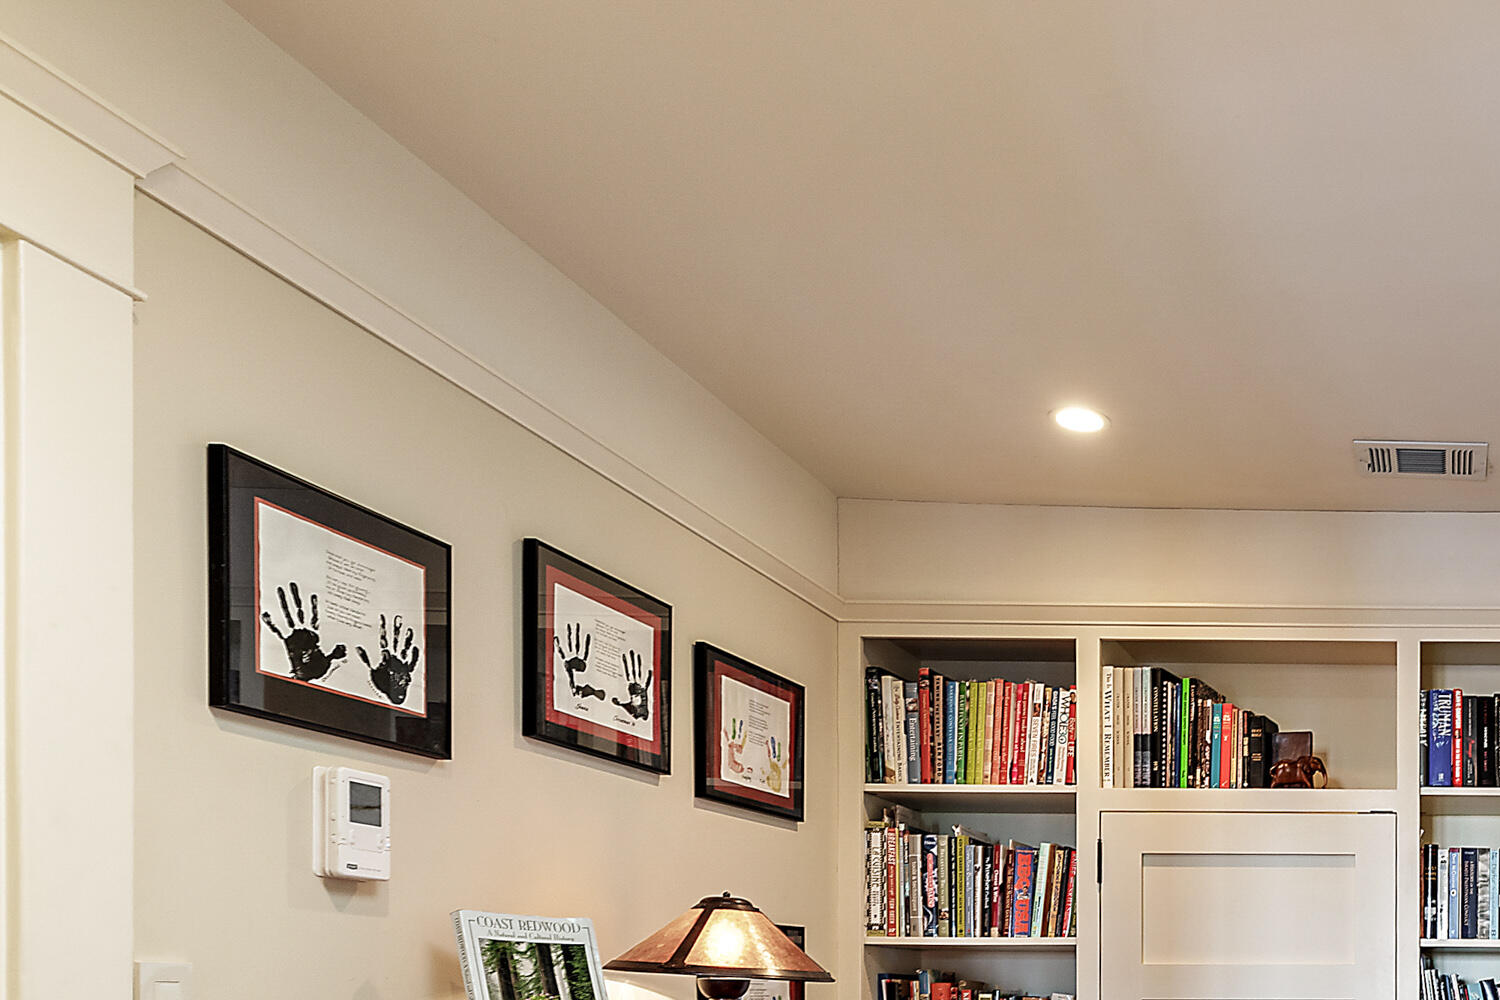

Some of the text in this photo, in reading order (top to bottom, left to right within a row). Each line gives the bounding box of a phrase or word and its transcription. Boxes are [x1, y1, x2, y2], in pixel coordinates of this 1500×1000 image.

[1104, 690, 1112, 722] WHAT
[1437, 693, 1452, 737] TRUMAN
[958, 732, 964, 742] IN
[872, 855, 880, 888] CUISINE
[1014, 853, 1032, 934] BBQ USA
[477, 915, 582, 934] COAST REDWOOD
